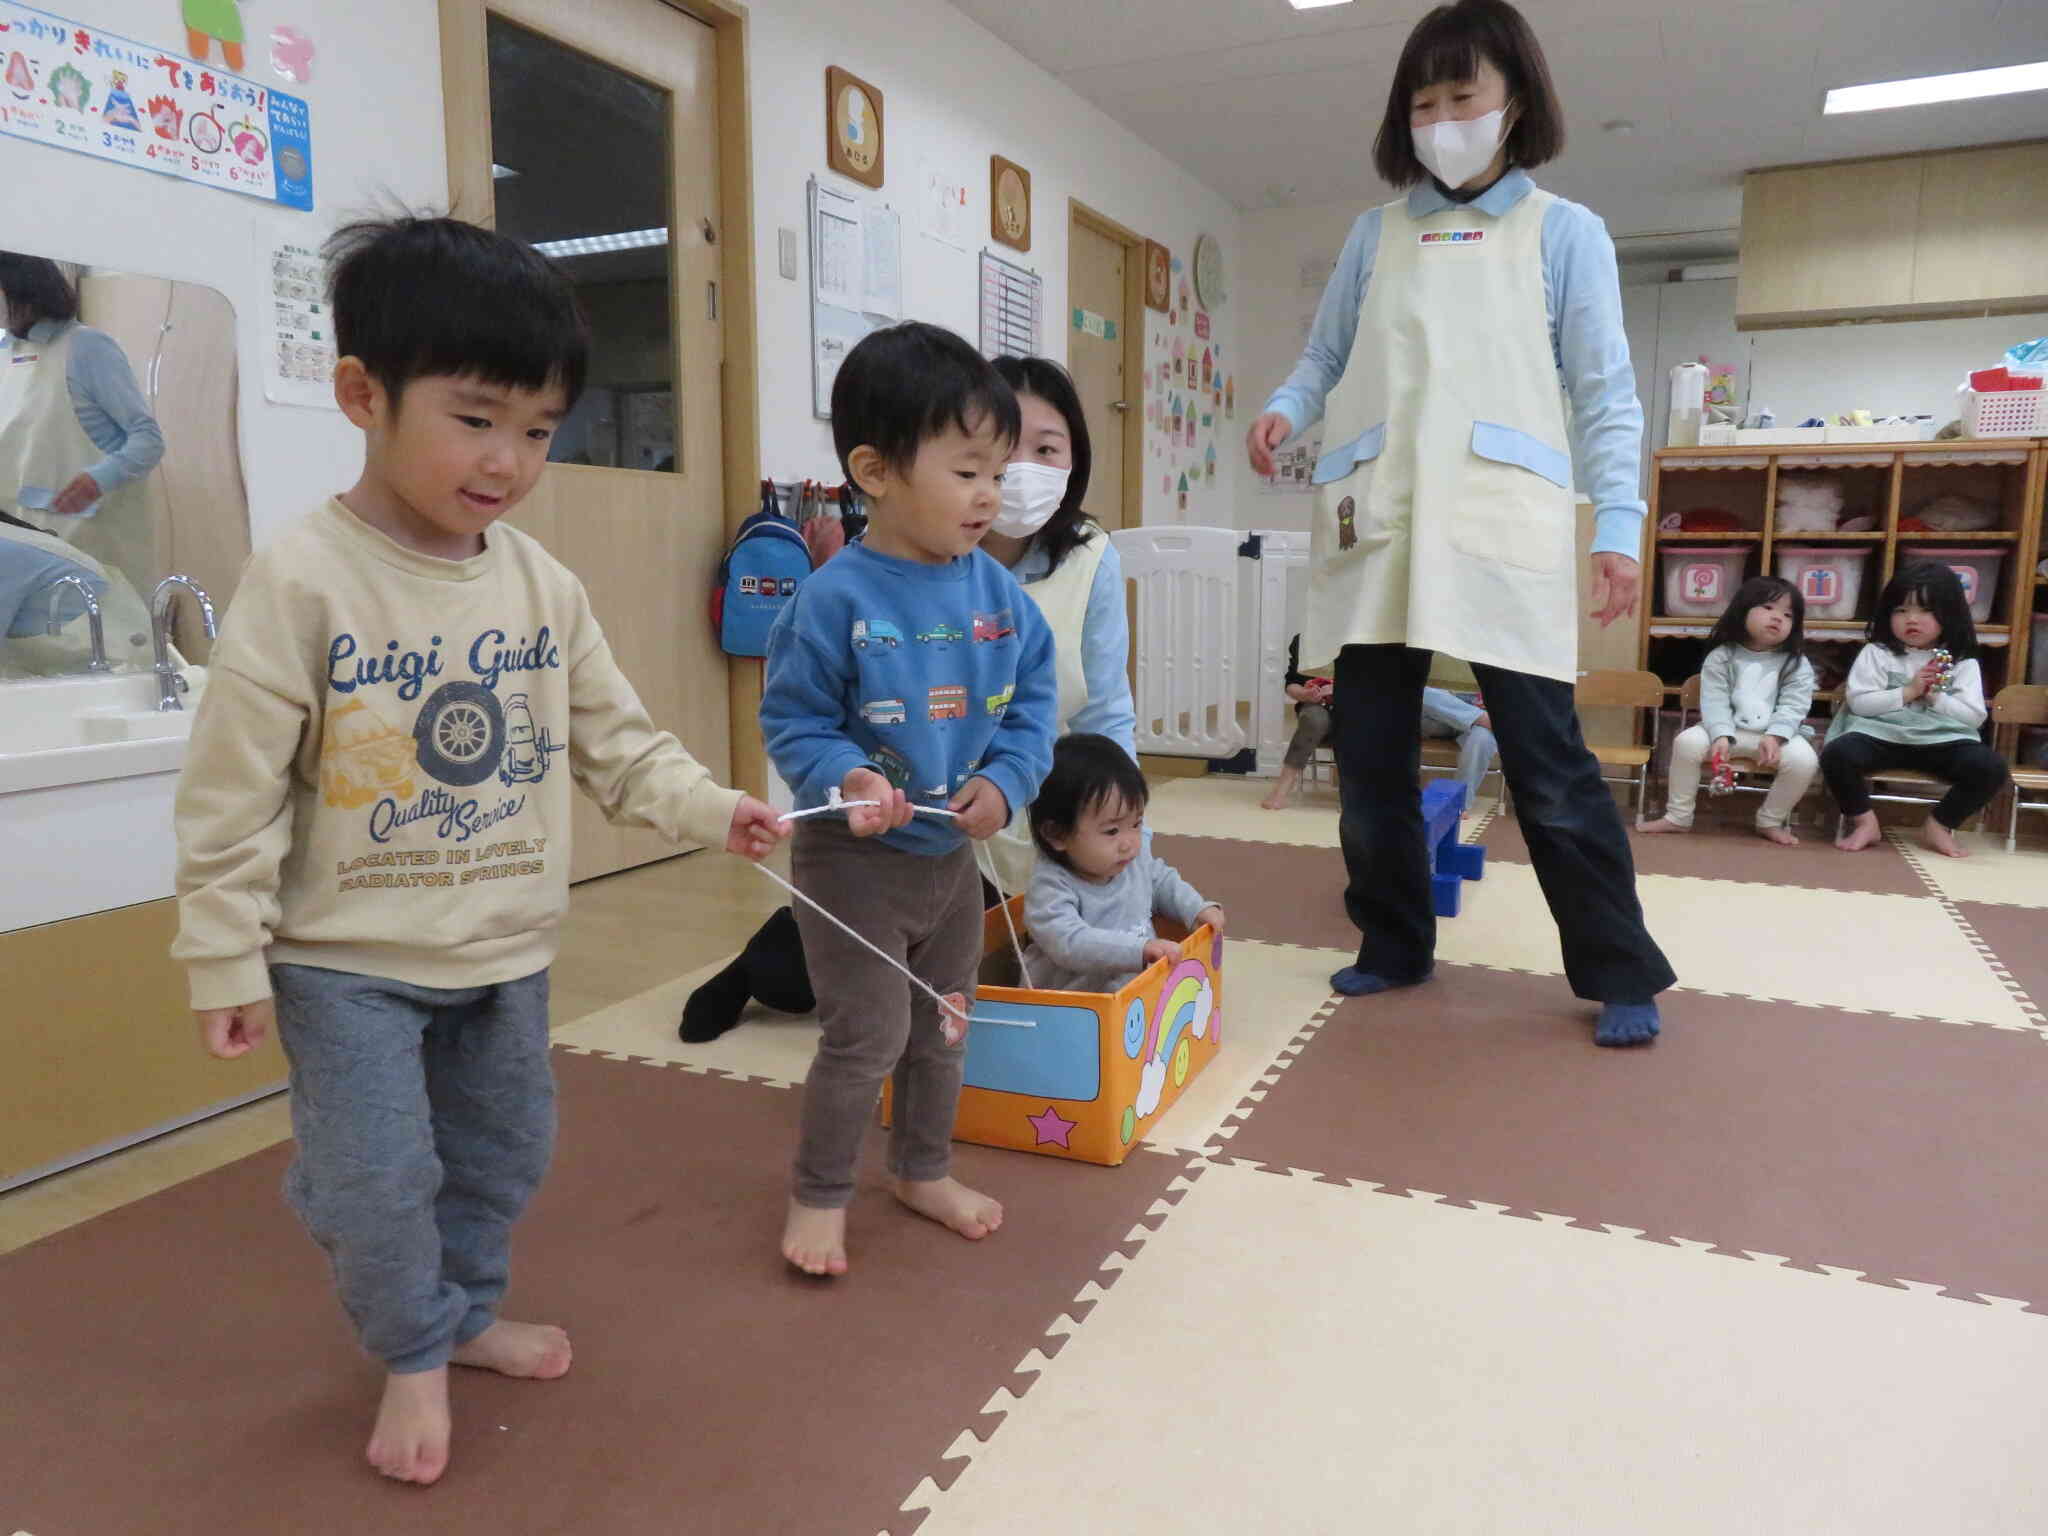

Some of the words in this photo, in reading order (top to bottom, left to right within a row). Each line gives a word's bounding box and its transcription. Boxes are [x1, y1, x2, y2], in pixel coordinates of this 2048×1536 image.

[56, 119, 66, 136] 2
[102, 131, 112, 147] 3
[146, 143, 158, 159] 4
[191, 156, 200, 171] 5
[229, 167, 239, 181] 6
[328, 633, 444, 700] Luigi
[369, 787, 458, 843] Quality
[455, 795, 525, 842] Service
[336, 849, 440, 876] LOCATED
[446, 849, 471, 865] IN
[475, 838, 547, 861] LOVELY
[337, 871, 455, 892] RADIATOR
[459, 859, 545, 885] SPRINGS
